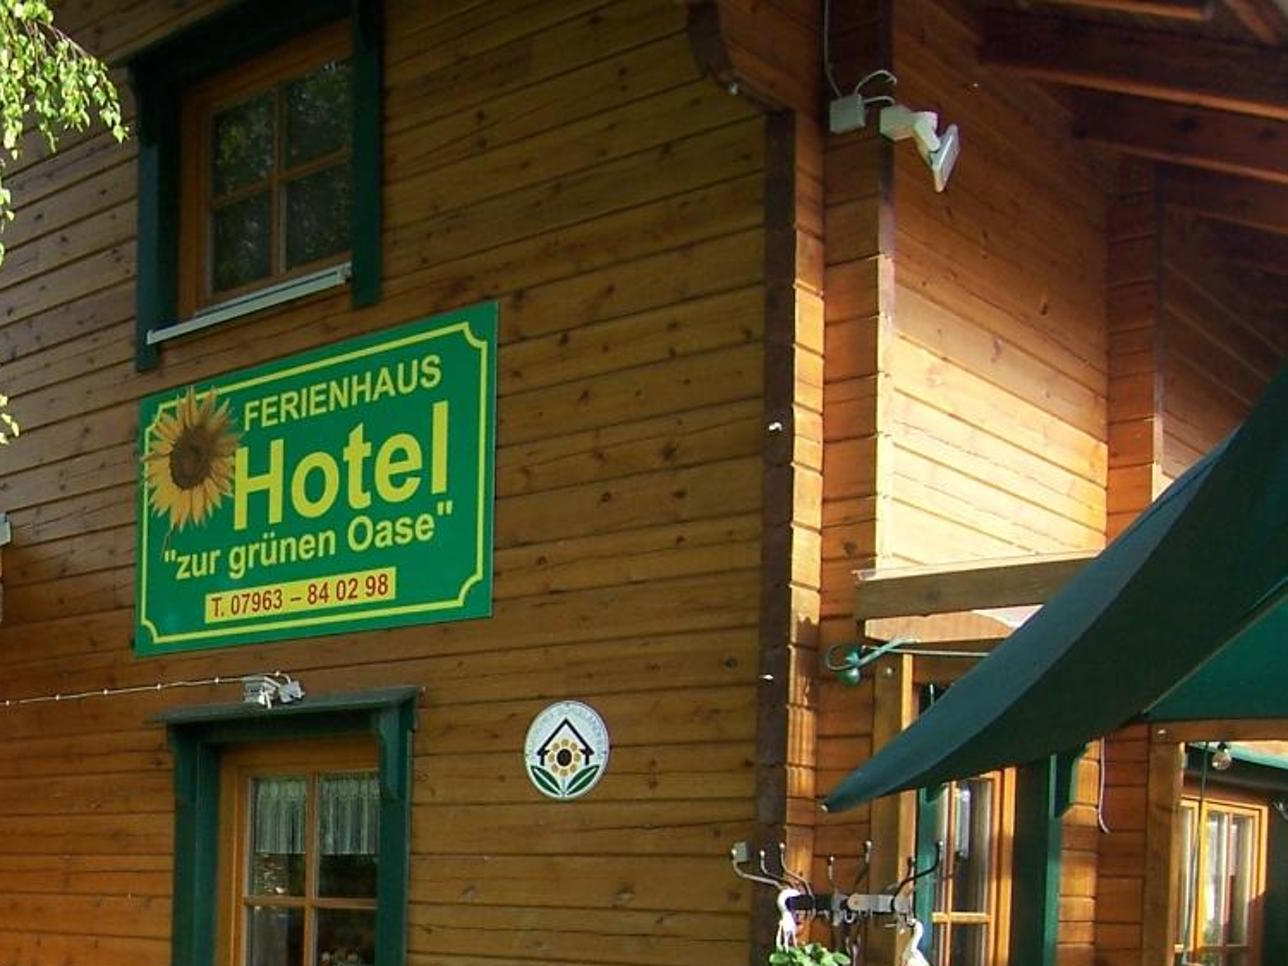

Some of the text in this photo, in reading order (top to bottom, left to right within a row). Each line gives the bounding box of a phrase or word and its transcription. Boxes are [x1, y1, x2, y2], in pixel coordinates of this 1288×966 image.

[244, 354, 442, 432] FERIENHAUS
[233, 400, 449, 531] Hotel
[163, 500, 453, 580] "zur grünen Oase"
[211, 597, 225, 617] T.
[231, 589, 283, 615] 07963
[307, 582, 329, 605] 84
[336, 578, 358, 601] 02
[365, 573, 389, 597] 98
